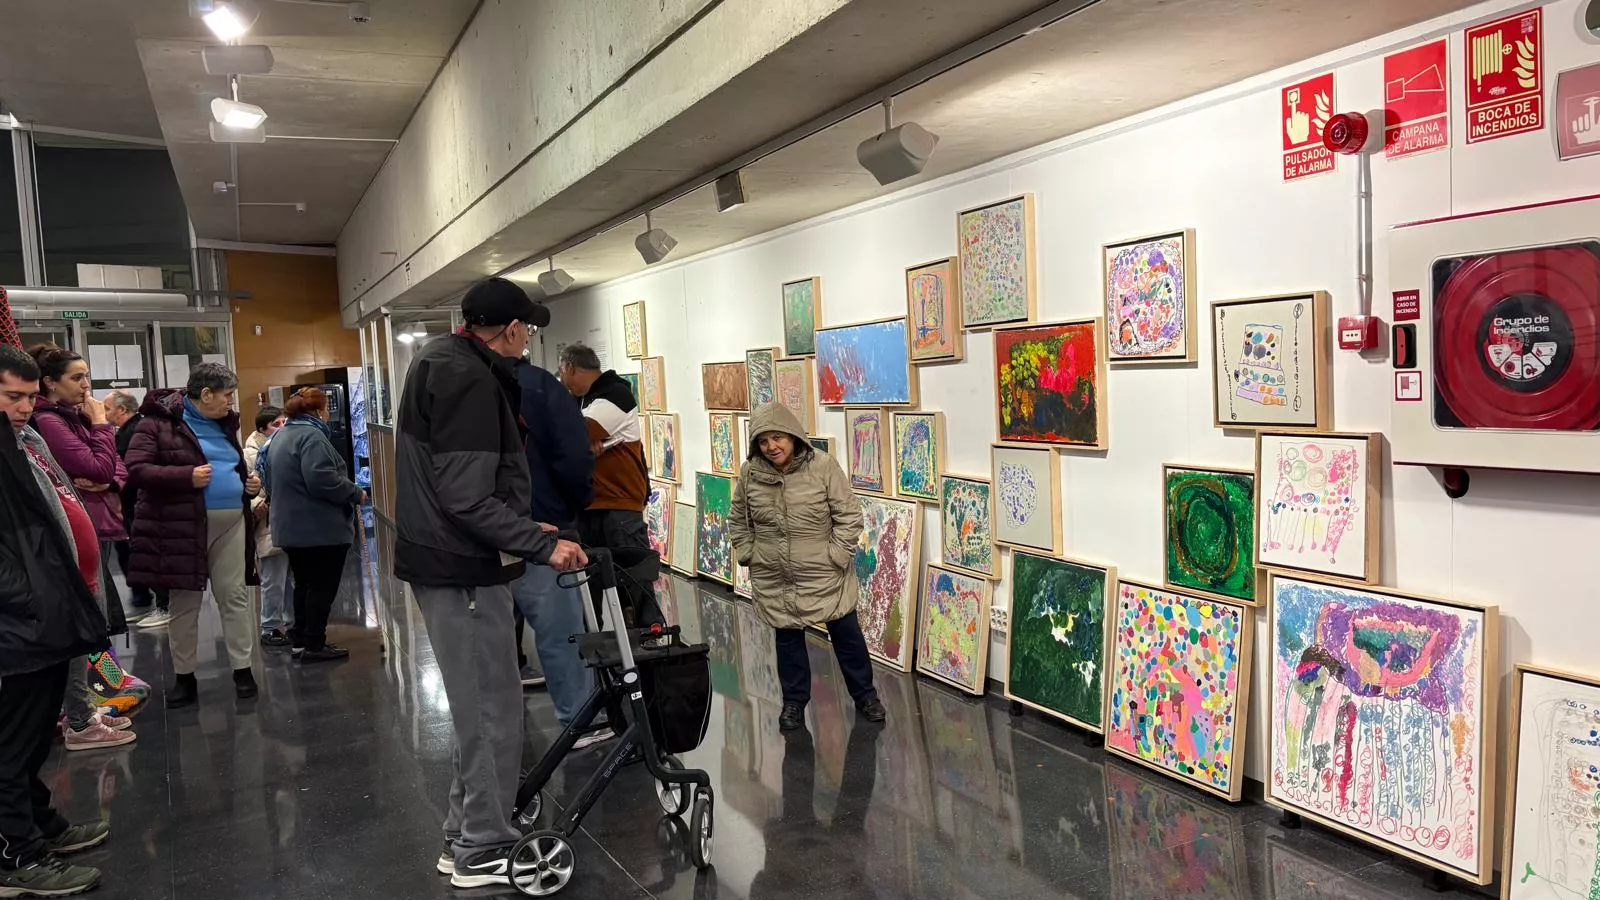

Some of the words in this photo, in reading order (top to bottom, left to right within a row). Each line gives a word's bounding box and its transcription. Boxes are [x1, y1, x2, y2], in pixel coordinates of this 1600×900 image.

[1478, 105, 1511, 123] BOCA
[1514, 101, 1531, 115] DE
[1392, 121, 1440, 142] CAMPANA
[1472, 113, 1537, 137] INCENDIOS
[1387, 142, 1401, 155] DE
[1403, 133, 1444, 152] ALARMA
[1286, 166, 1297, 178] DE
[1298, 157, 1333, 175] ALARMA
[1493, 317, 1532, 326] Grupo
[1534, 315, 1550, 324] de
[603, 741, 632, 778] SPACE
